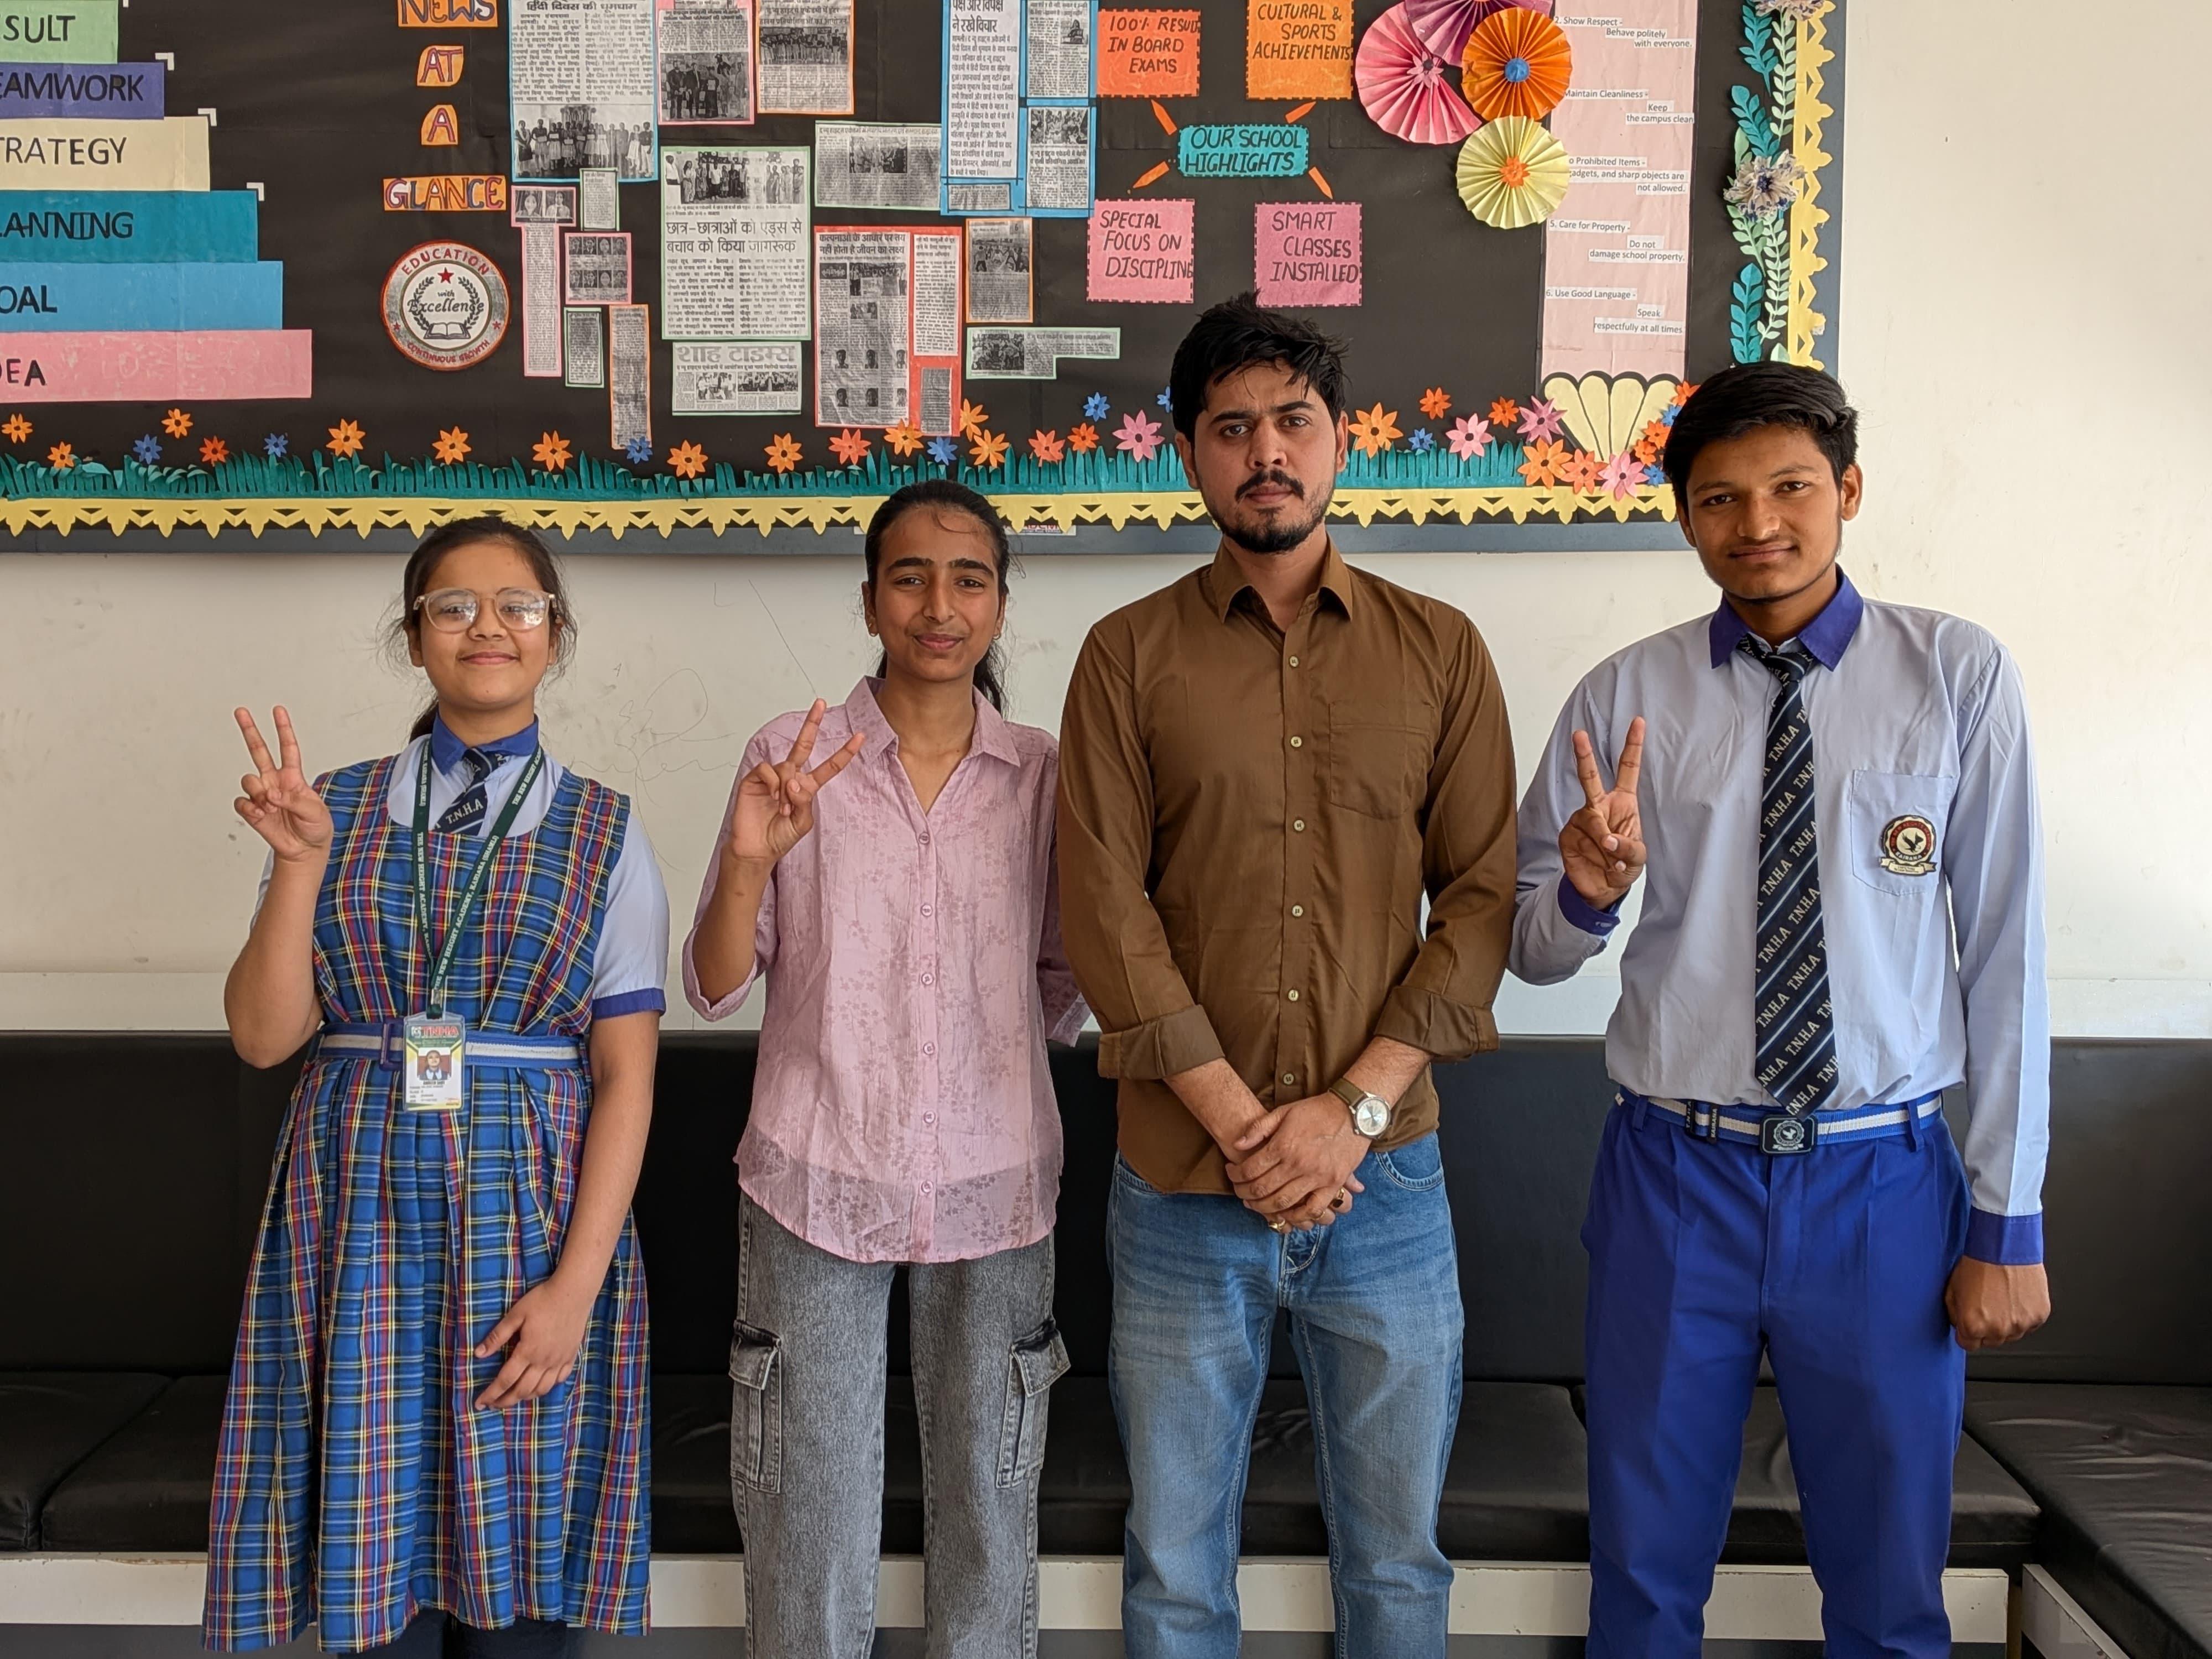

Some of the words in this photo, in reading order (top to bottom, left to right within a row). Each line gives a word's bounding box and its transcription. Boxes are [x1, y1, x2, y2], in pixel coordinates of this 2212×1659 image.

[551, 1, 580, 11] दिवस
[582, 1, 597, 10] की
[1257, 3, 1328, 20] CULTURAL
[1332, 7, 1342, 20] &
[3, 14, 76, 44] SULT
[976, 15, 998, 32] विचार
[1563, 17, 1585, 25] Show
[1587, 17, 1618, 27] Respect
[1281, 23, 1336, 41] SPORTS
[1606, 28, 1635, 36] Behave
[1637, 30, 1666, 39] politely
[1107, 36, 1129, 53] IN
[1133, 38, 1184, 53] BOARD
[1253, 42, 1353, 61] ACHIEVEMENTS
[1653, 40, 1692, 49] everyone.
[419, 48, 463, 82] AT
[1129, 58, 1177, 73] EXAMS
[1599, 90, 1644, 98] Cleanliness
[1648, 104, 1668, 113] Keep
[428, 108, 456, 143] A
[1641, 116, 1672, 125] campus
[1191, 128, 1235, 149] OUR
[1239, 129, 1301, 148] SCHOOL
[0, 137, 127, 165] RATEGY
[1185, 151, 1295, 174] HIGHLIGHTS
[1576, 157, 1617, 165] Prohibited
[1619, 158, 1640, 166] Items
[1569, 169, 1599, 179] adgets,
[1618, 171, 1640, 180] sharp
[1641, 172, 1670, 181] objects
[385, 176, 504, 210] GLANCE
[1652, 184, 1686, 192] allowed.
[0, 212, 133, 239] ANNING
[791, 218, 802, 234] से
[1099, 210, 1162, 229] SPECIAL
[1271, 210, 1337, 232] SMART
[1592, 222, 1625, 233] Property
[666, 241, 695, 253] बचाव
[698, 238, 713, 253] को
[717, 237, 745, 253] किया
[1103, 230, 1150, 251] FOCUS
[1159, 234, 1182, 251] ON
[1283, 236, 1352, 258] CLASSES
[401, 248, 490, 275] EDUCATION
[1589, 251, 1620, 259] damage
[1648, 253, 1686, 263] property.
[1105, 256, 1193, 279] DISCIPLINE
[1270, 262, 1359, 283] INSTALLED
[437, 289, 455, 298] with
[1594, 290, 1631, 300] Language
[406, 298, 484, 315] Excellence
[1637, 309, 1661, 318] Speak
[1594, 322, 1639, 332] respectfully
[1650, 324, 1660, 332] all
[1661, 325, 1682, 333] times
[406, 341, 457, 363] CONTINUOUS
[458, 339, 490, 362] GROWTH
[677, 346, 722, 362] शाह
[727, 346, 795, 363] टाइम्स
[0, 358, 46, 386] EA
[1768, 725, 1799, 761] T.N.H.A
[446, 799, 483, 824] T.N.H.A
[1764, 791, 1796, 827] T.N.H.A
[417, 863, 425, 891] HEIGHT
[1761, 859, 1793, 896] T.N.H.A
[1788, 887, 1820, 925] T.N.H.A
[438, 958, 448, 974] NEW
[444, 928, 459, 957] HEIGHT
[455, 893, 473, 928] ACADEMY,
[1758, 926, 1791, 963] T.N.H.A
[1787, 954, 1821, 990] T.N.H.A
[1756, 992, 1790, 1027] T.N.H.A
[422, 1026, 459, 1036] TNHA
[1785, 1021, 1820, 1056] T.N.H.A
